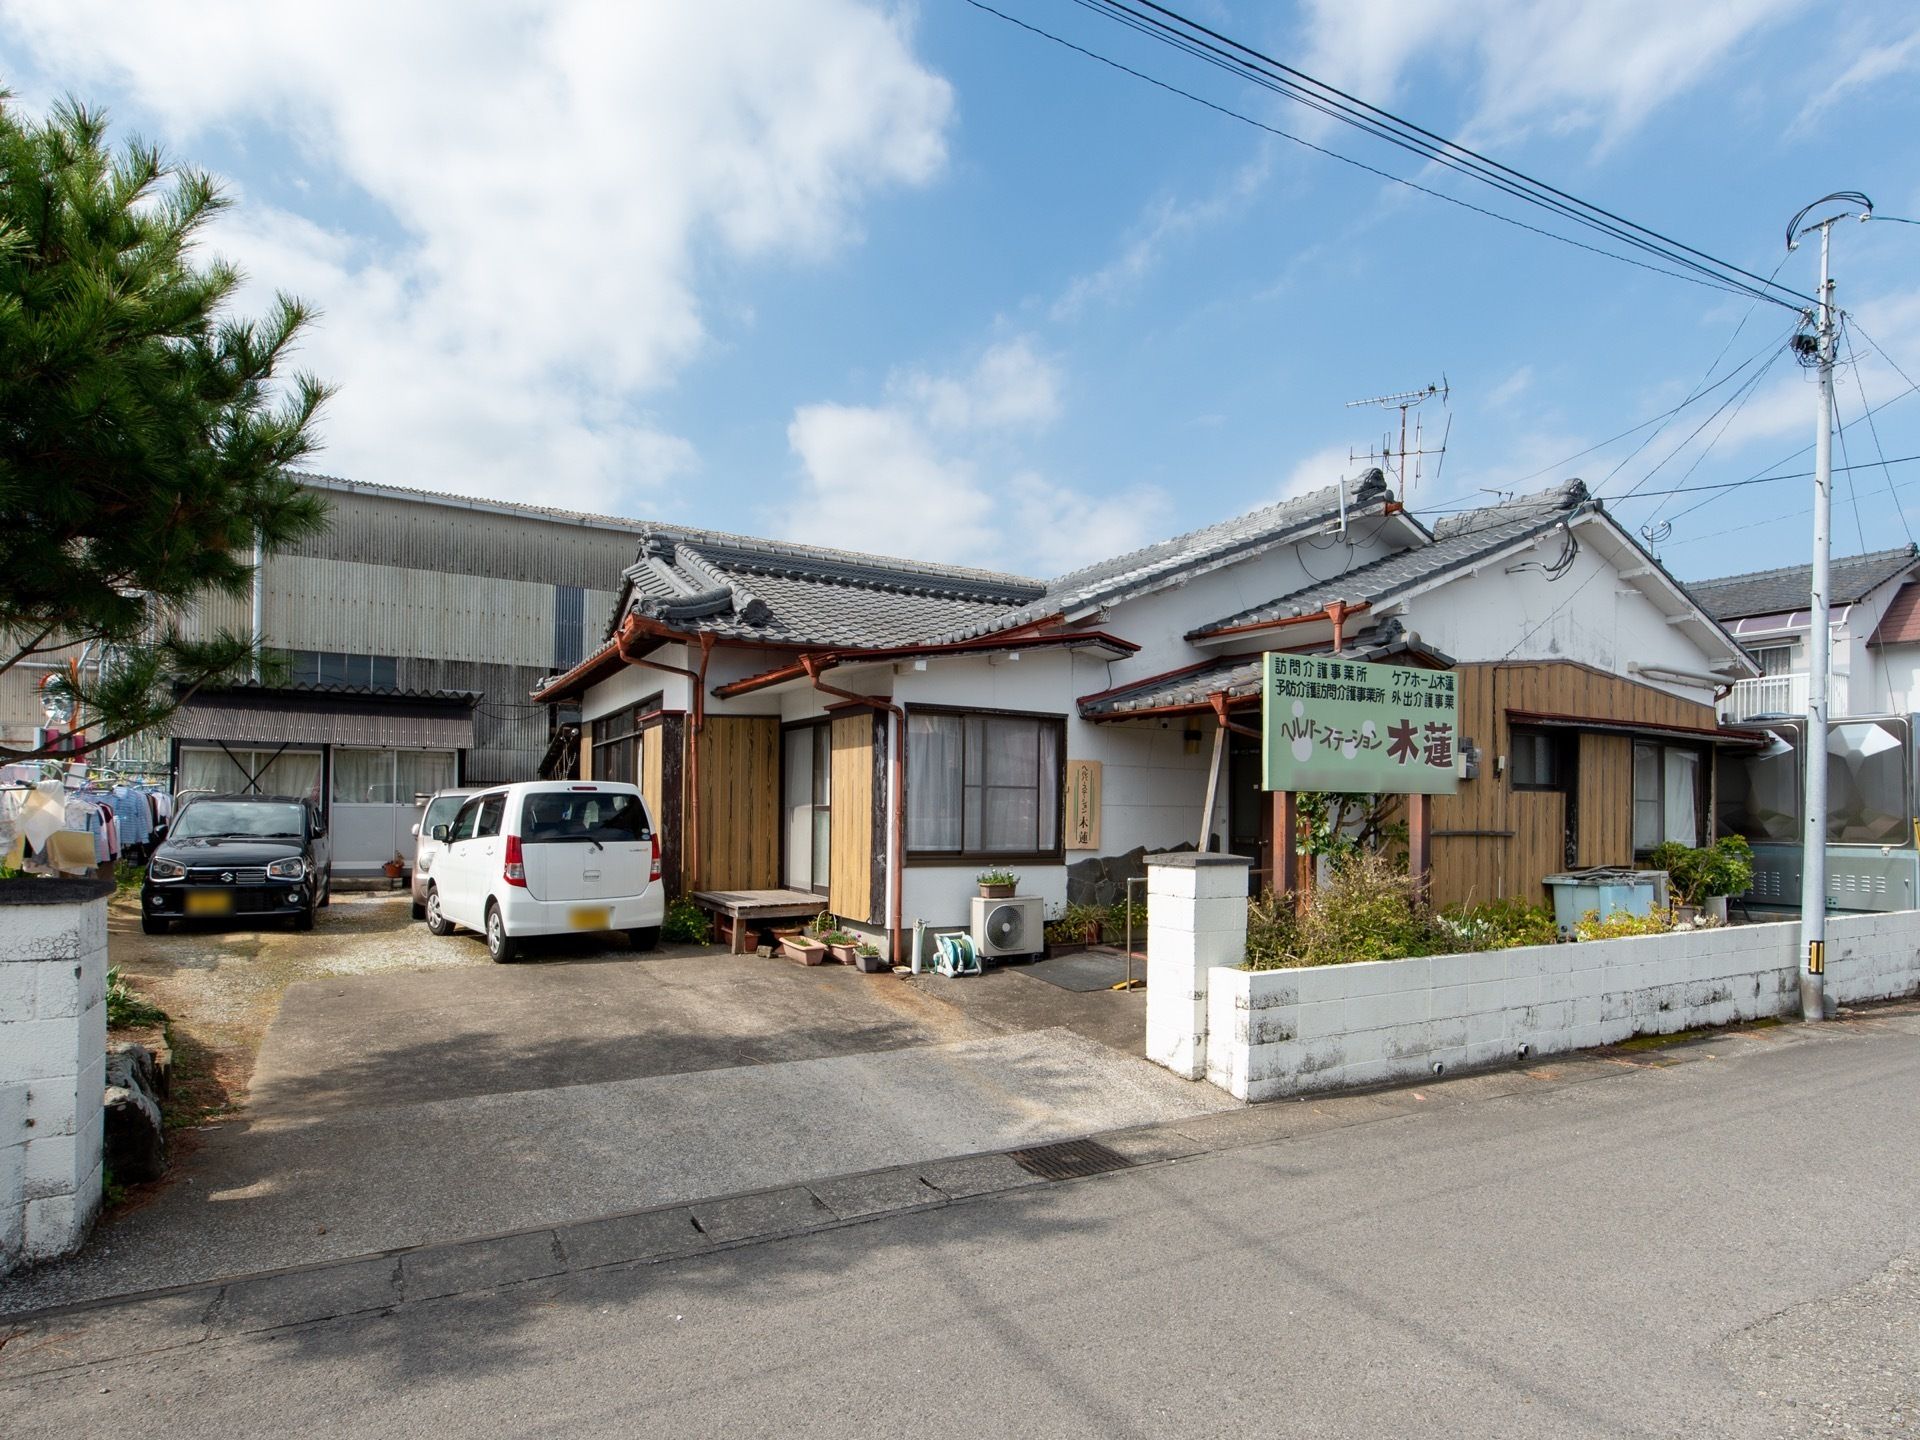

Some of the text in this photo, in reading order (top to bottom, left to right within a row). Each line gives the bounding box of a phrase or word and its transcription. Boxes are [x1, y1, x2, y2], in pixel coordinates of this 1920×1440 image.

[1275, 657, 1367, 682] 訪問介護事業所
[1392, 670, 1454, 691] ケアホーム木蓮
[1275, 679, 1386, 704] 予防介護訪問介護事業所
[1392, 690, 1454, 709] 外出介護事業
[1281, 717, 1454, 768] ヘルパーステーション 木蓮
